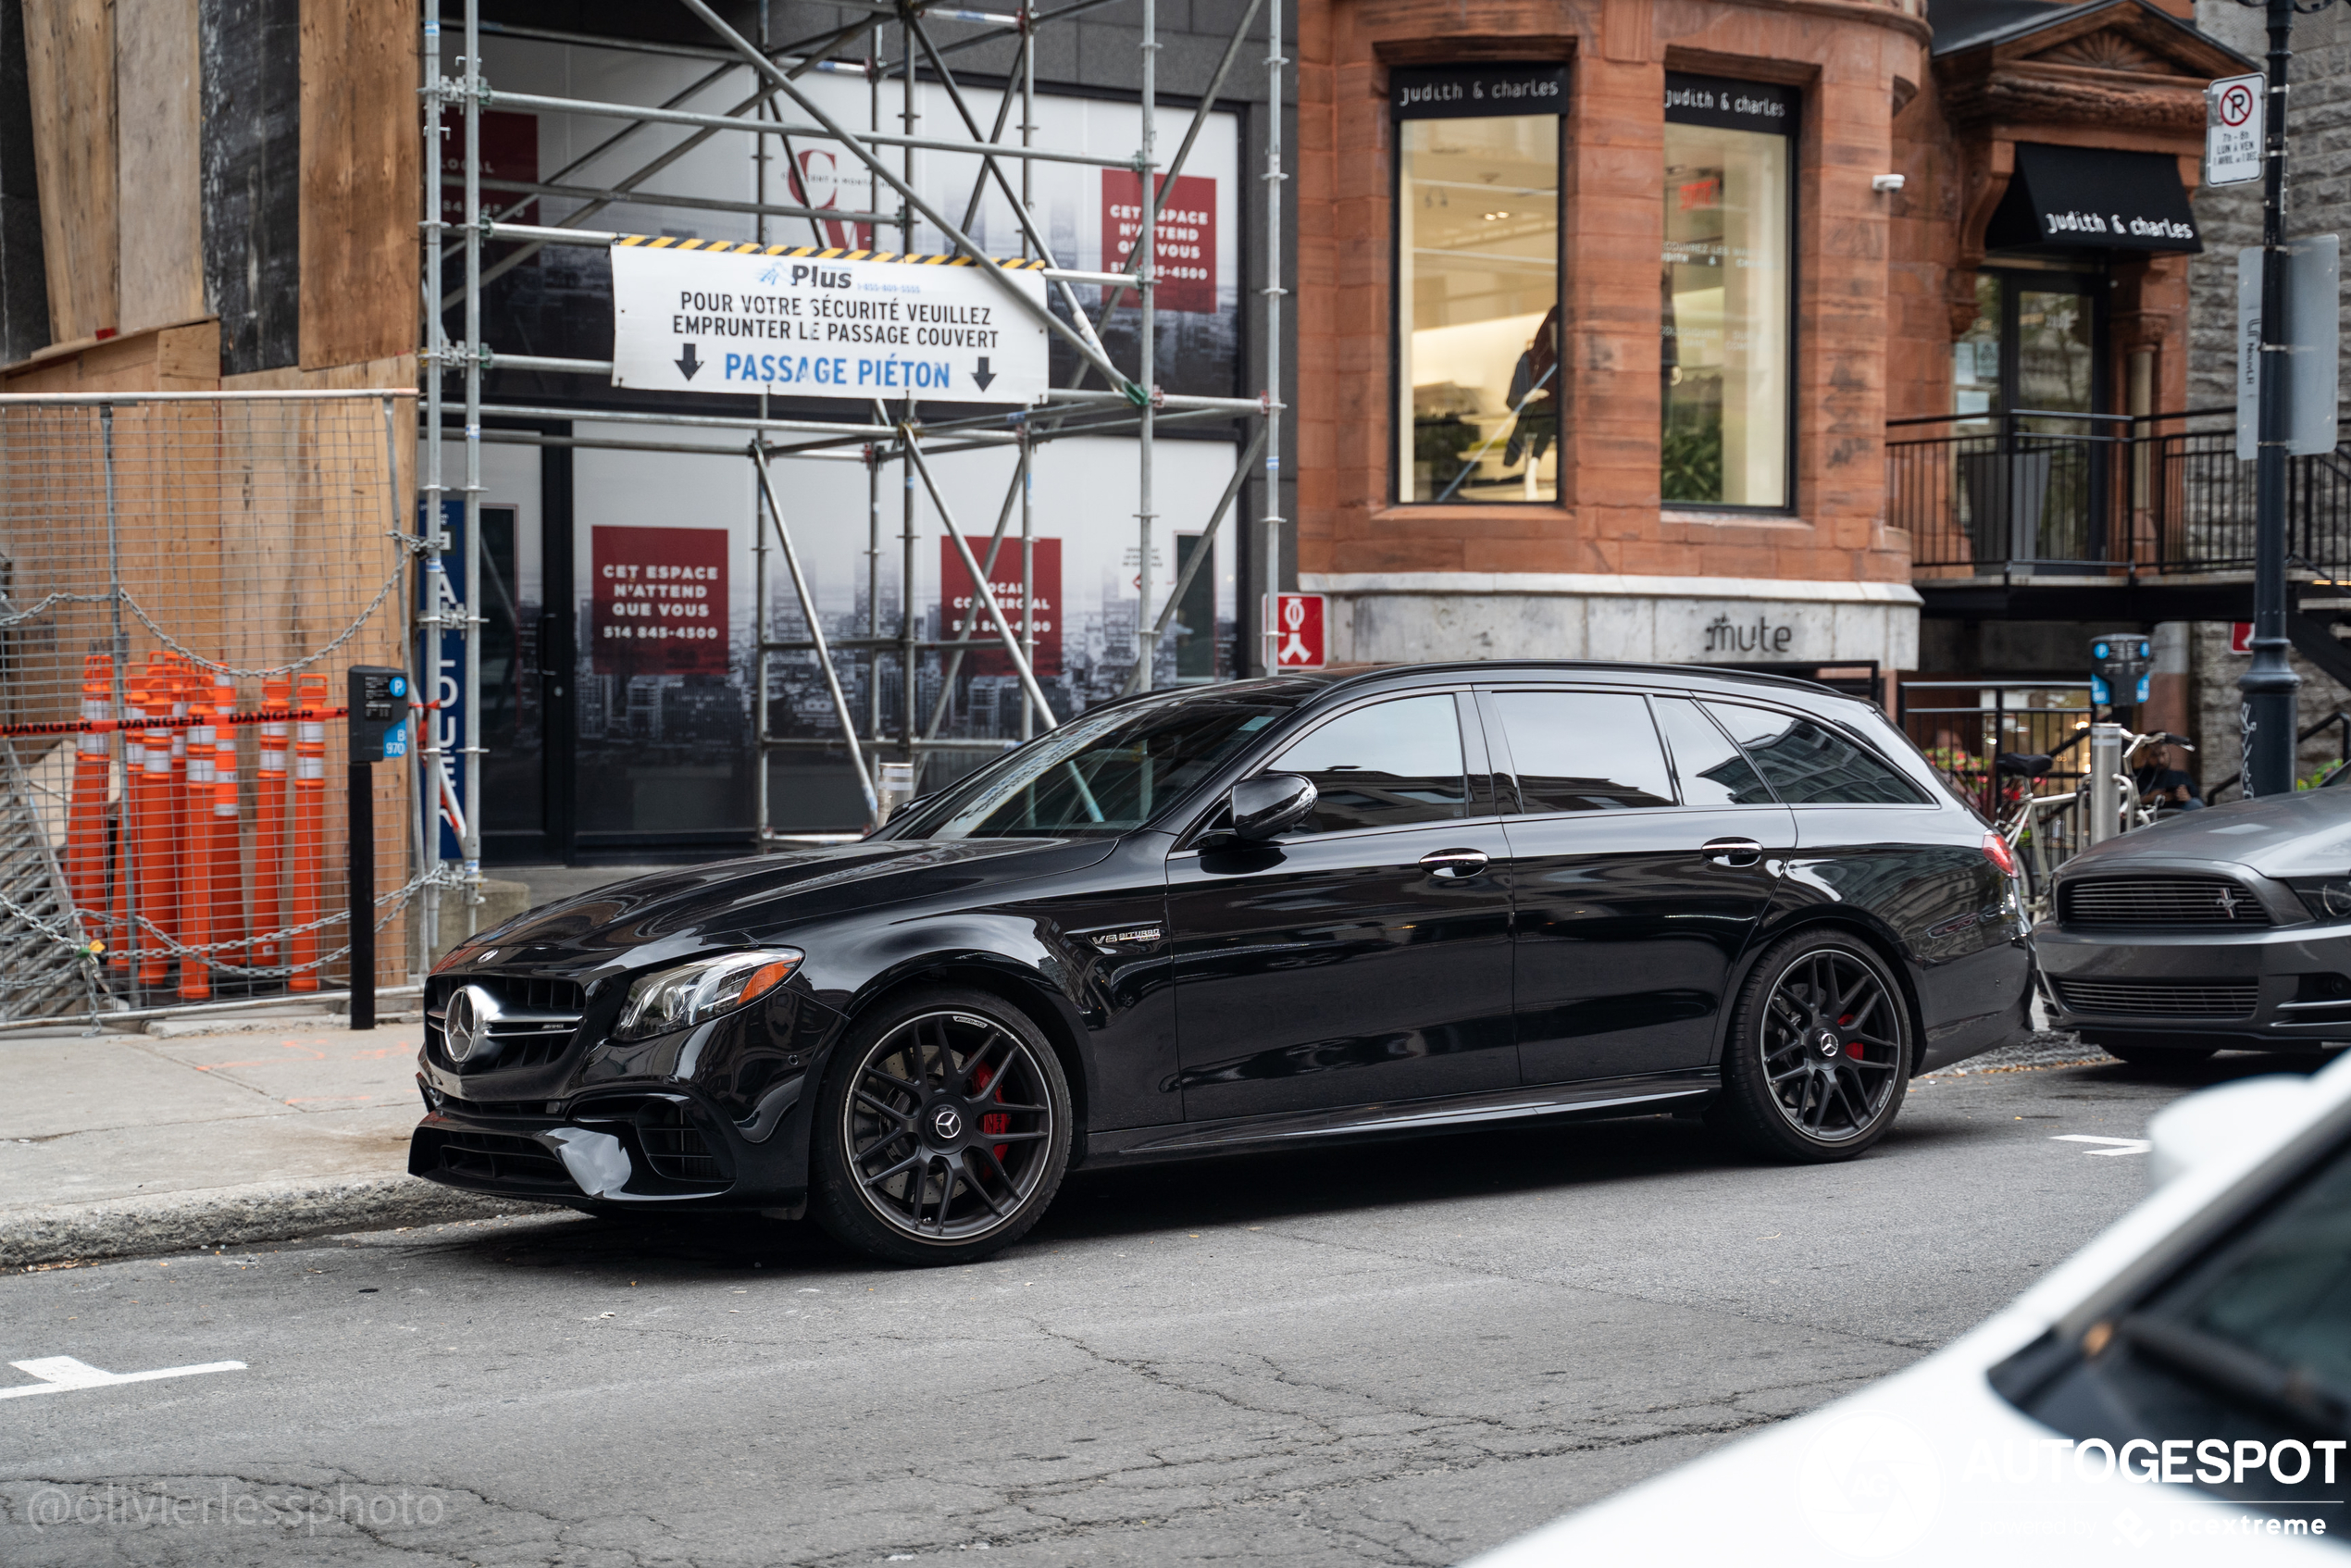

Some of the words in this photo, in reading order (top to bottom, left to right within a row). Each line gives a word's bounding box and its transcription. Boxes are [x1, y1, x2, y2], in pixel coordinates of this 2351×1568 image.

[1399, 81, 1463, 107] judith
[1473, 81, 1484, 99] &
[1491, 78, 1560, 100] charles
[1663, 87, 1714, 109] judith
[1720, 92, 1731, 111] &
[1734, 94, 1786, 118] charles
[1110, 205, 1141, 219] CET
[1158, 208, 1209, 225] SPACE
[2046, 210, 2107, 234] judith
[2110, 214, 2127, 234] &
[2130, 216, 2194, 239] charles
[1156, 243, 1200, 259] VOUS
[791, 265, 852, 289] Plus
[681, 291, 733, 313] POUR
[740, 294, 802, 317] VOTRE
[810, 293, 900, 321] SÉCURITÉ
[907, 304, 991, 326] VEUILLEZ
[673, 315, 790, 340] EMPRUNTER
[798, 321, 820, 341] LE
[827, 323, 910, 345] PASSAGE
[917, 327, 999, 349] COUVERT
[725, 353, 847, 385] PASSAGE
[858, 353, 951, 389] PIÉTON
[603, 564, 640, 579] CET
[646, 566, 718, 580] ESPACE
[614, 583, 708, 599] N'ATTEND
[988, 582, 1024, 594] OCAL
[612, 602, 652, 616] QUE
[658, 603, 709, 617] VOUS
[603, 626, 631, 639] 514
[637, 626, 718, 640] 845-4500
[1708, 616, 1793, 653] mute
[394, 679, 403, 693] P
[2, 722, 93, 734] DANGER
[117, 716, 205, 729] DANGER
[228, 709, 314, 724] DANGER
[397, 728, 405, 741] B
[385, 741, 405, 755] 970
[1092, 934, 1117, 945] V8
[1118, 928, 1160, 939] BITURBO
